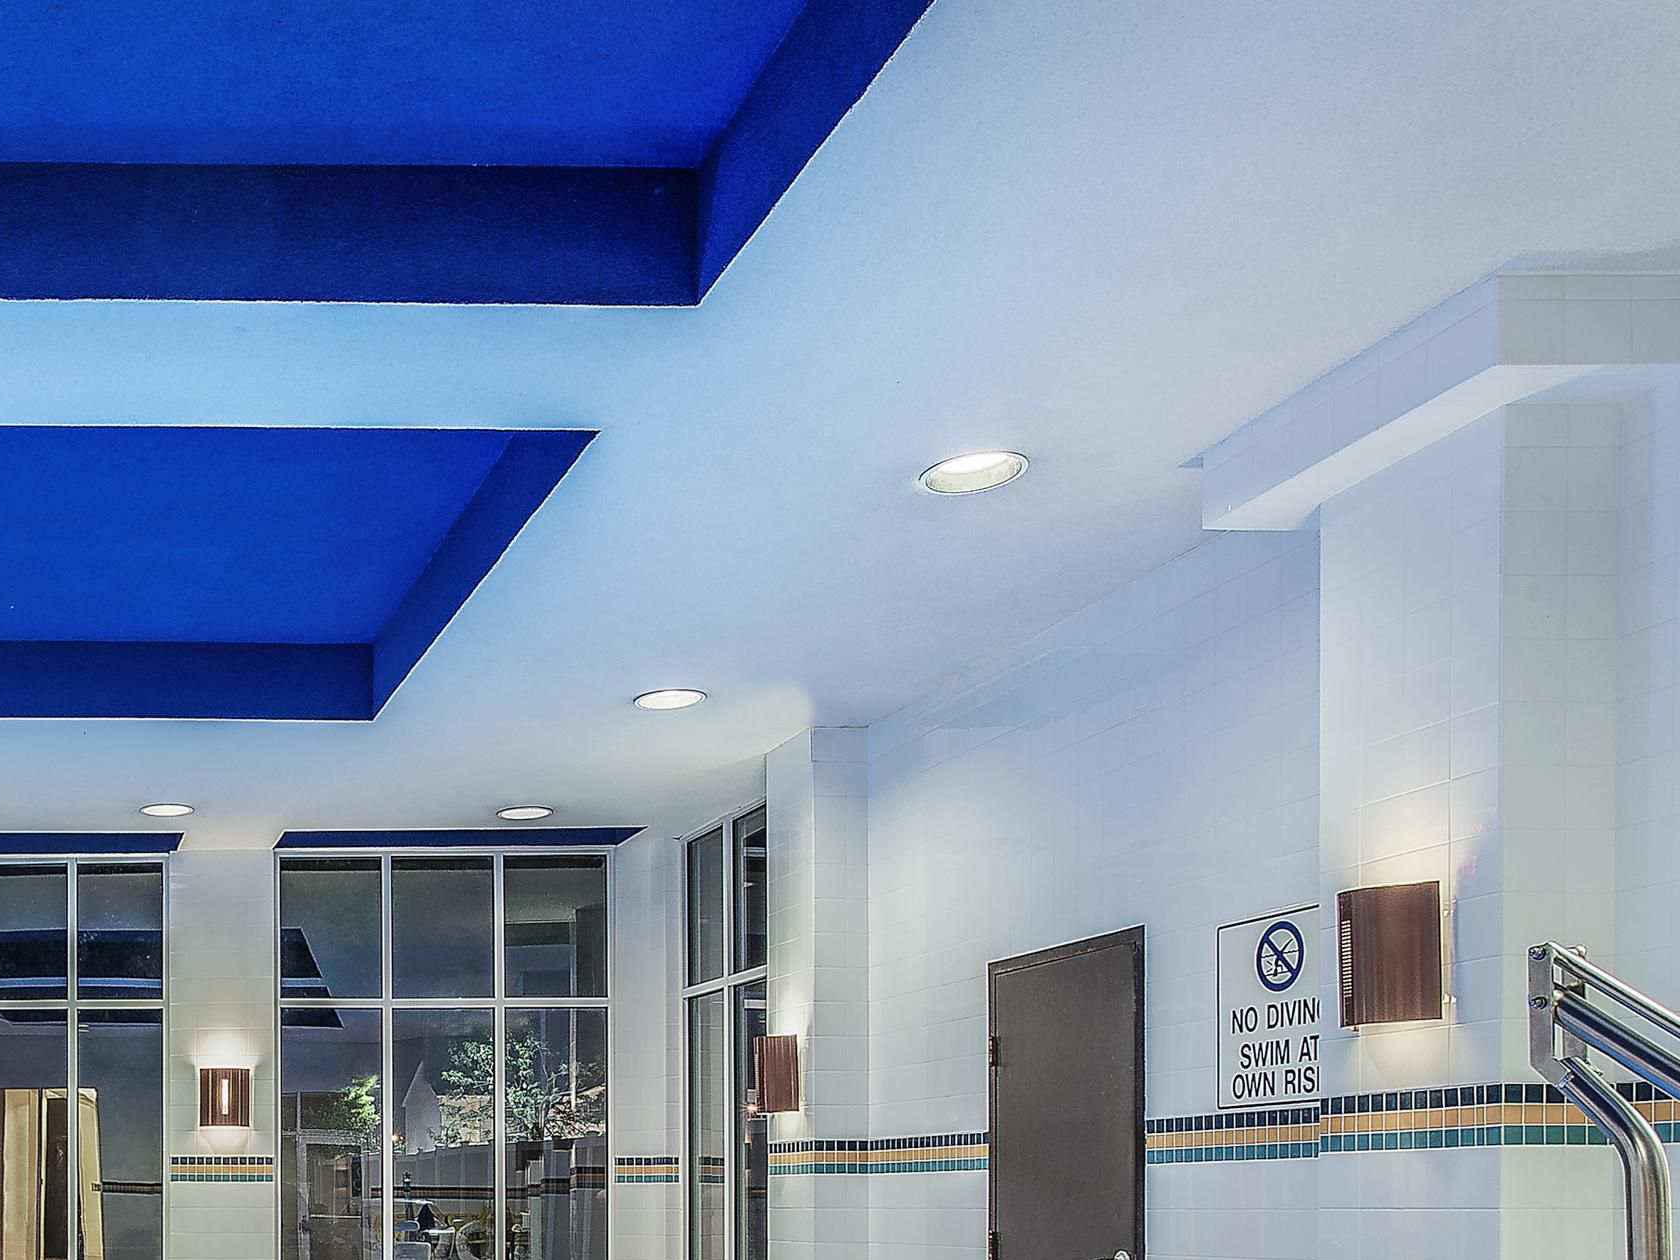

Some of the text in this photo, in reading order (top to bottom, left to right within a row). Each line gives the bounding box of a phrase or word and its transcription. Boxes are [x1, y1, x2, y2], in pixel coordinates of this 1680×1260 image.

[1231, 997, 1320, 1035] NO DIVIN
[1240, 1034, 1320, 1069] SWIM AT
[1232, 1066, 1320, 1100] OWN RIS
